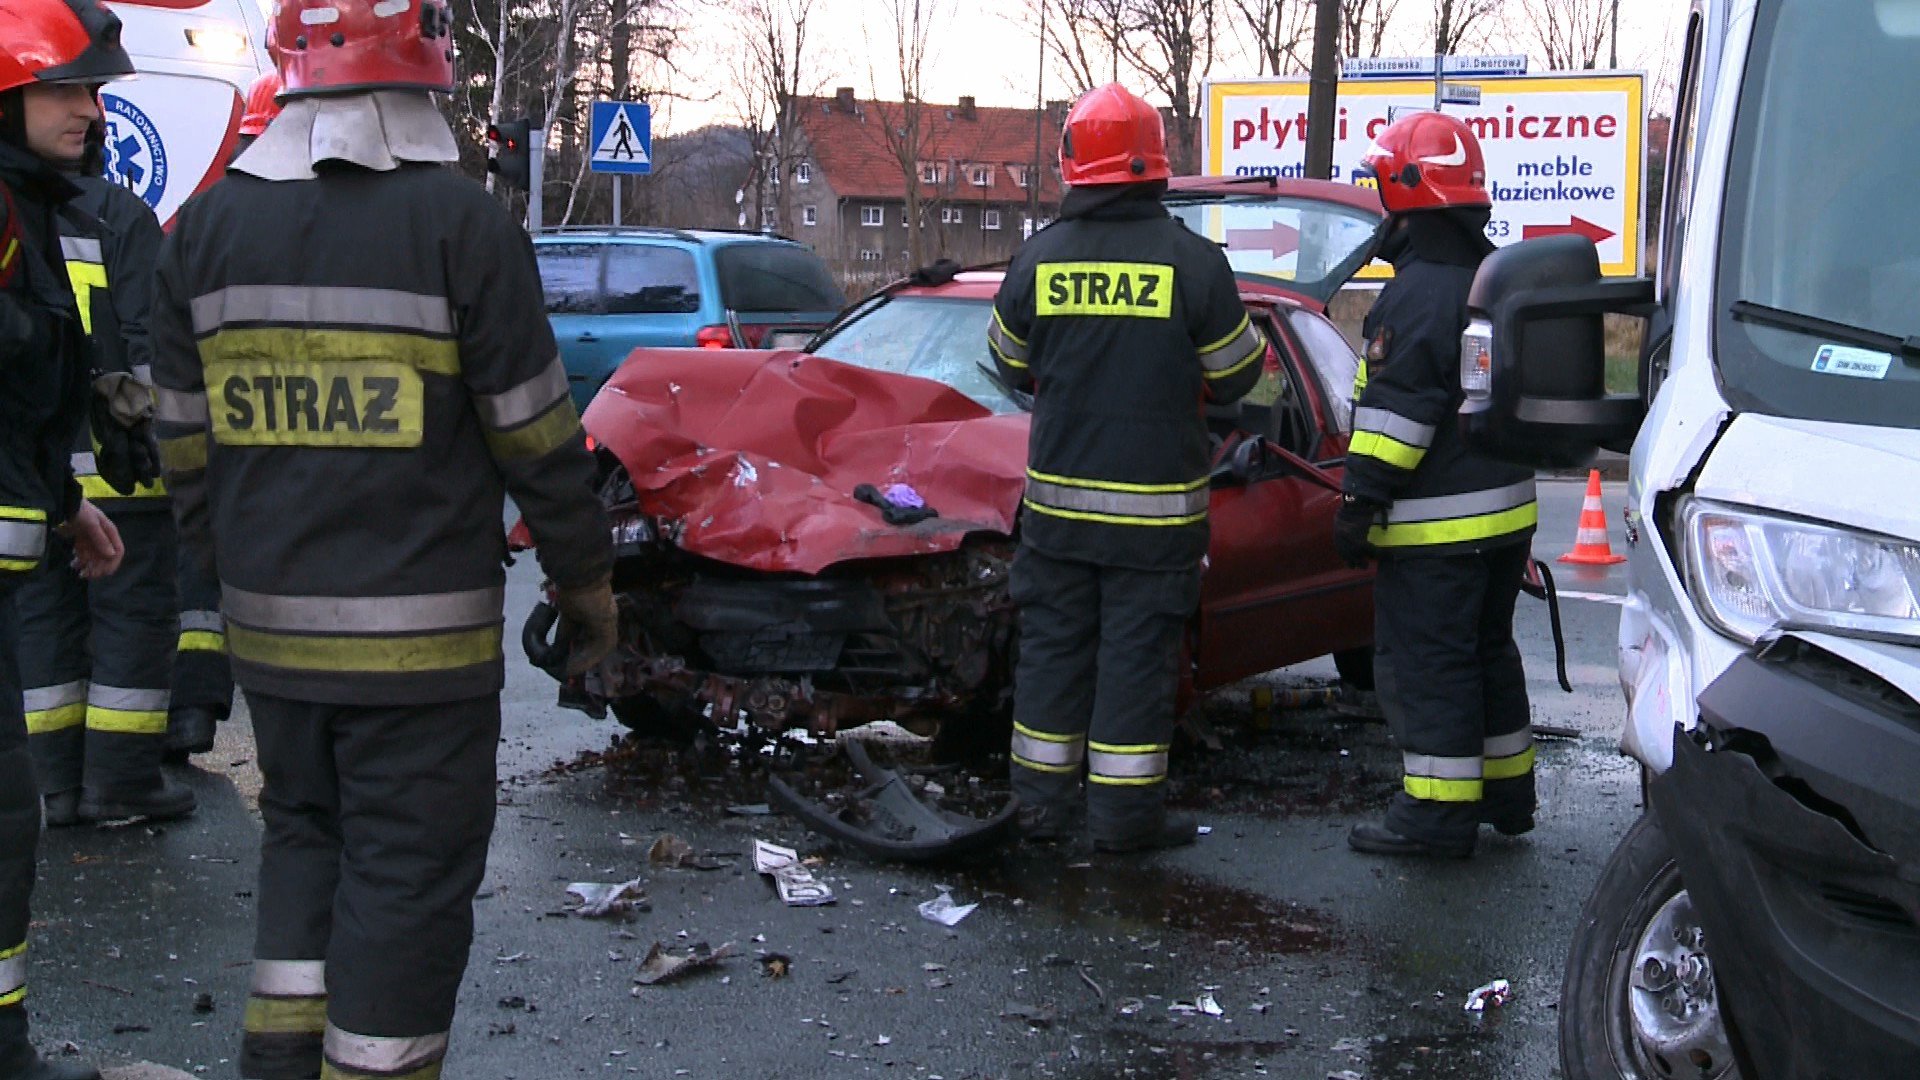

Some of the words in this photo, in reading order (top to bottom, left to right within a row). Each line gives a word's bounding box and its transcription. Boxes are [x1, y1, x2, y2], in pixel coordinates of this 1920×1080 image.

[1474, 58, 1521, 68] Dworcowa
[1233, 107, 1347, 149] płyti
[1366, 105, 1617, 139] cmiczne
[115, 101, 165, 186] RATOWNICTWO
[1517, 155, 1593, 176] meble
[1491, 180, 1615, 200] łazienkowe
